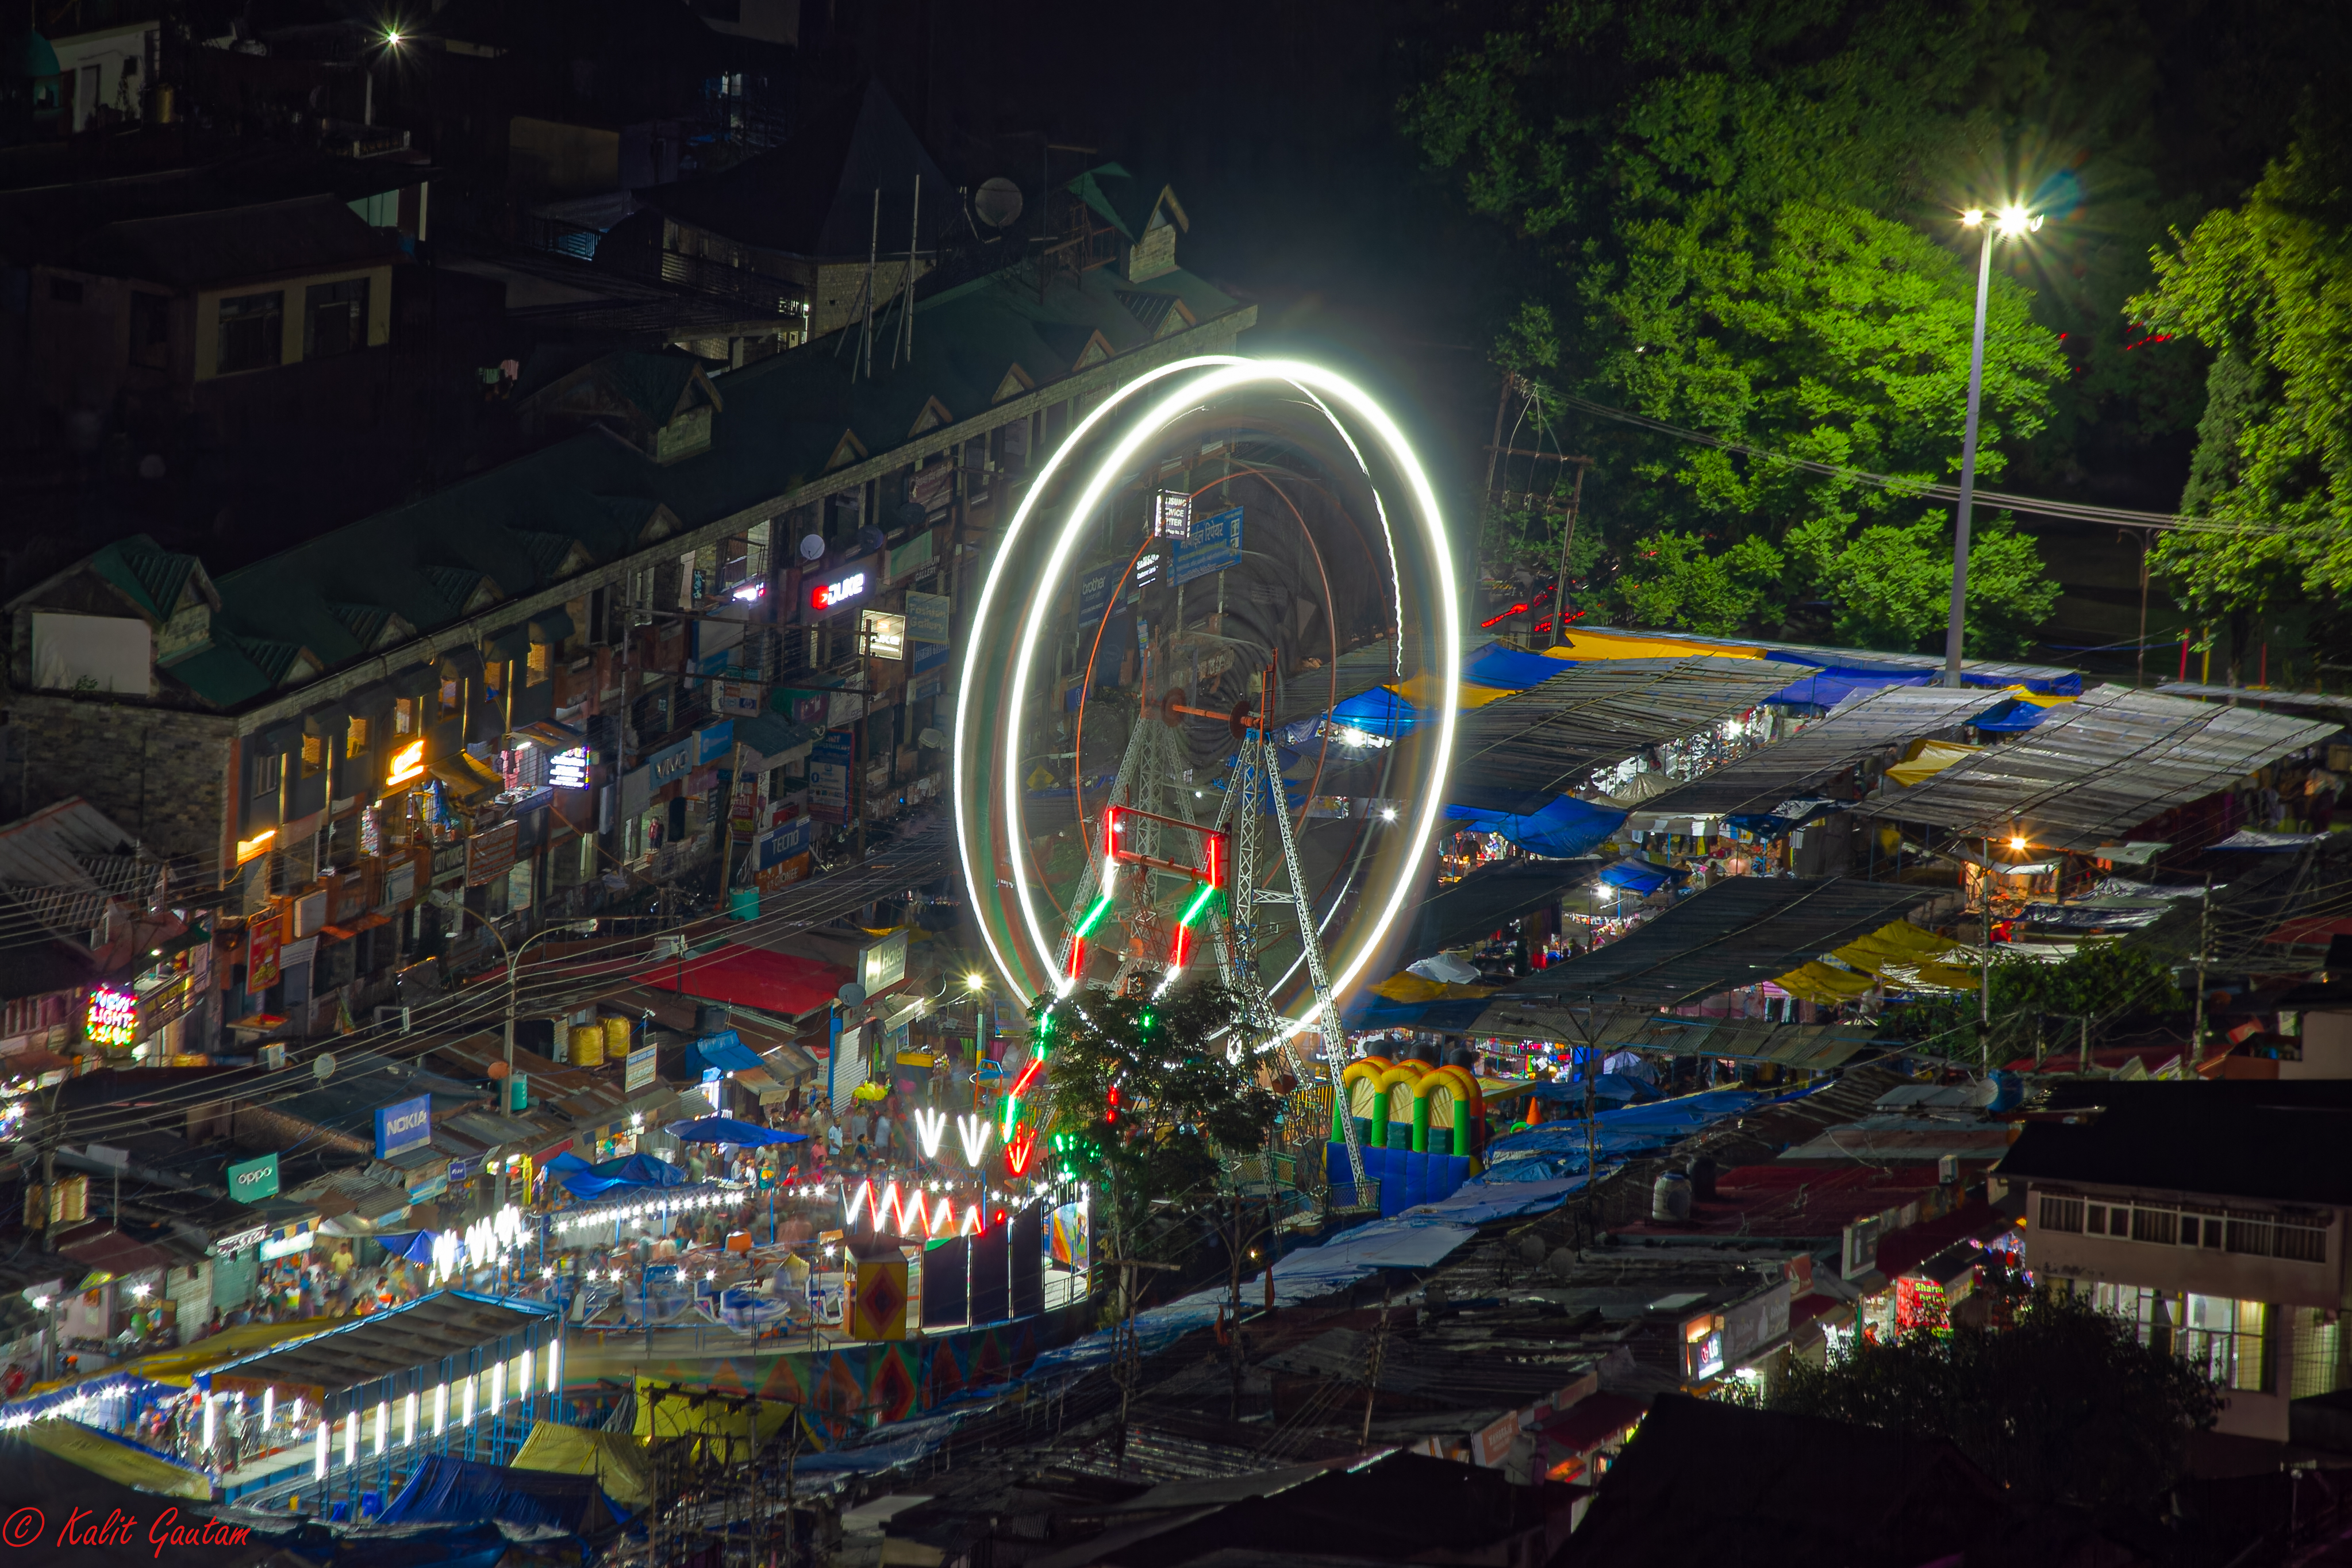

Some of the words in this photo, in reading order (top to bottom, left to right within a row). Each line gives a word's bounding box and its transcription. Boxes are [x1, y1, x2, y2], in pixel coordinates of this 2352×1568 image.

[1082, 575, 1106, 595] brother
[882, 943, 905, 970] Haier
[387, 1110, 426, 1137] NOKIA
[238, 1166, 273, 1186] oppo
